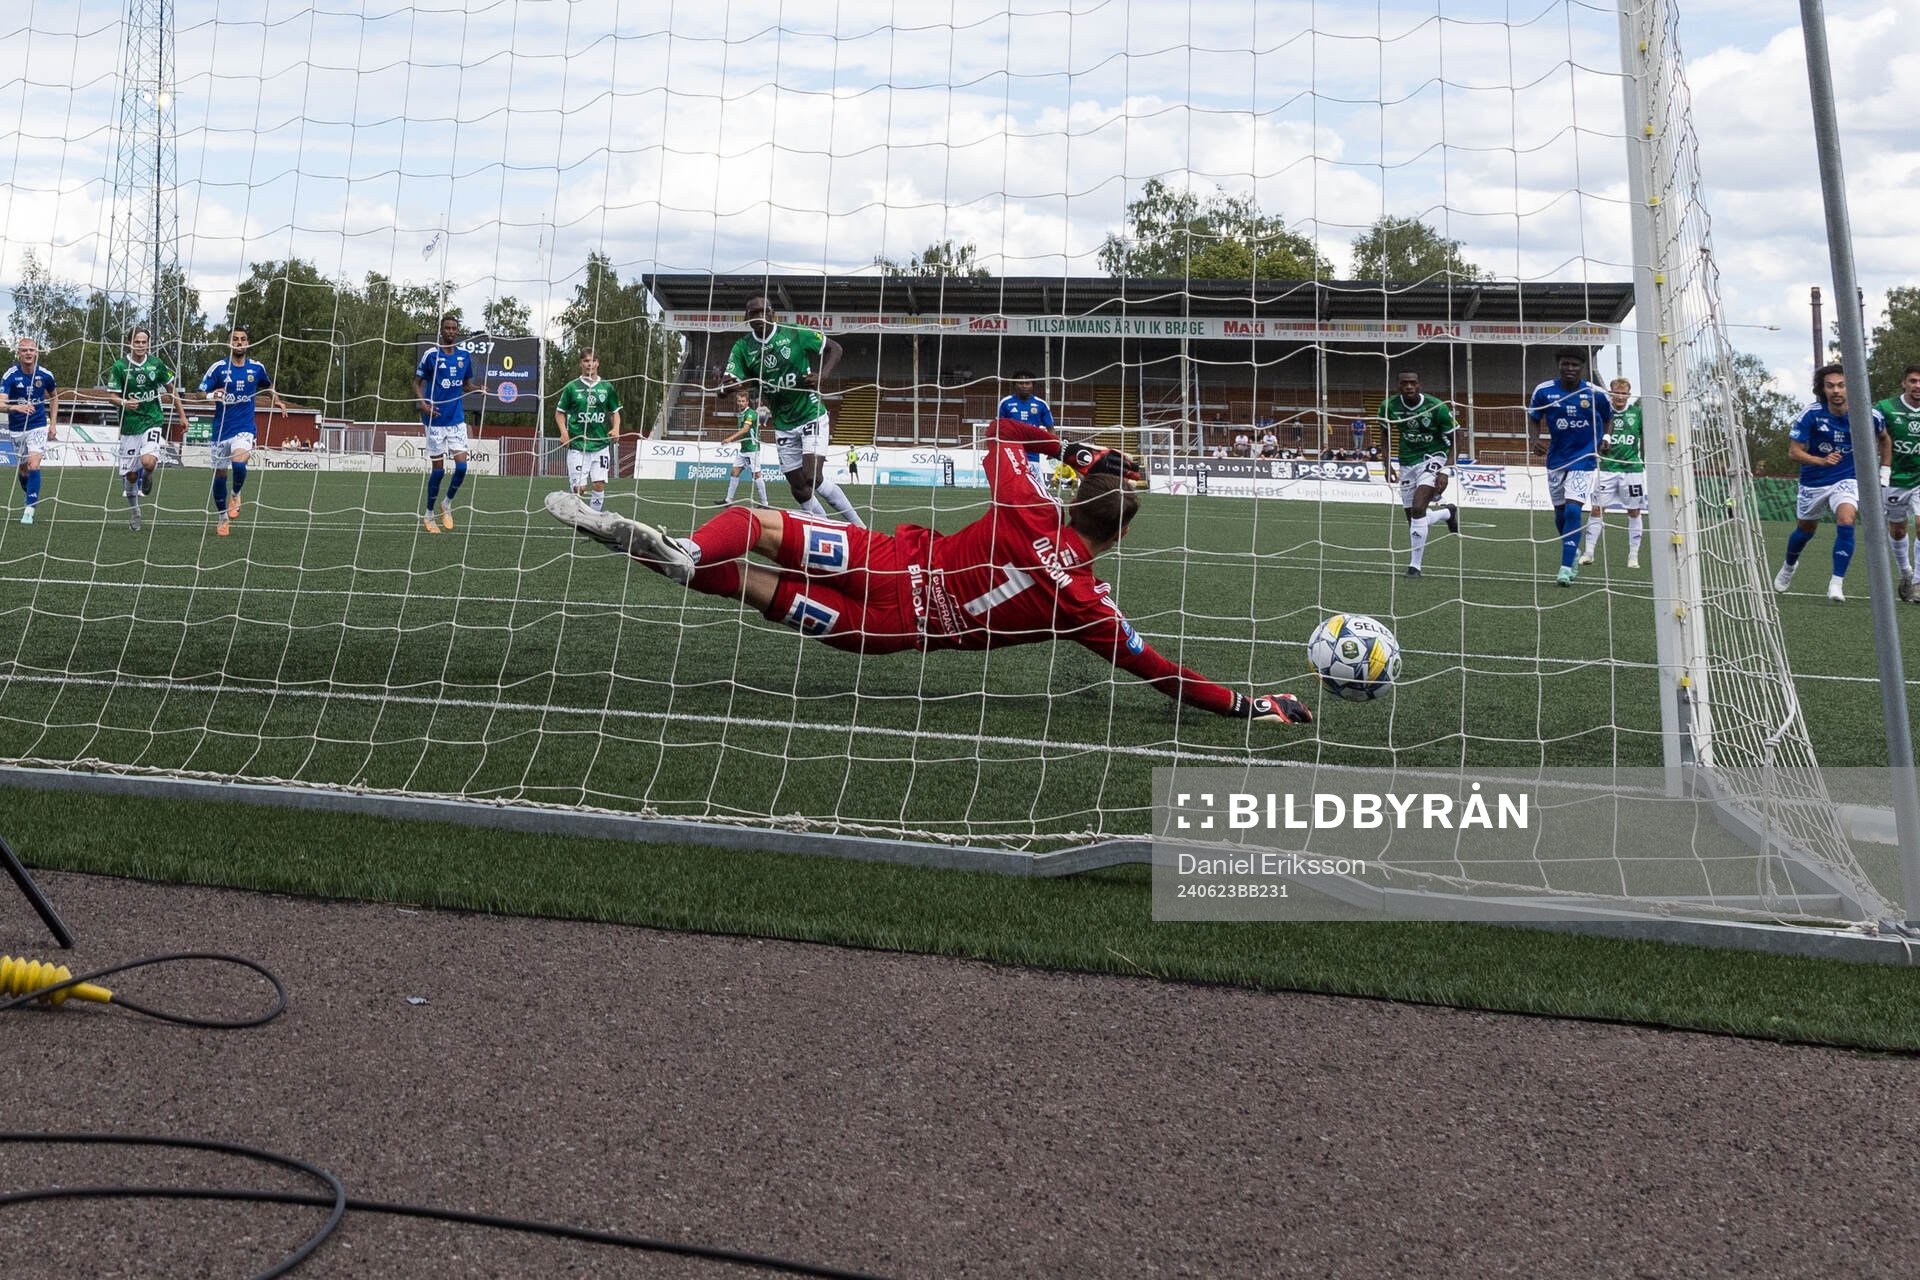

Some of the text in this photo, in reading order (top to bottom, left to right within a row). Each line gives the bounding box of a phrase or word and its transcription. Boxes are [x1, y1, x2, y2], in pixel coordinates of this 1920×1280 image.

[796, 314, 833, 327] MAXI
[969, 316, 1008, 329] MAXI
[1223, 320, 1265, 333] MAXI
[1026, 318, 1205, 336] TILLSAMMANS ÄR VI IK BRAGE
[1417, 323, 1461, 337] MAXI
[459, 341, 495, 354] 19:37
[503, 356, 513, 370] 0
[498, 370, 529, 378] Sundsvall
[577, 412, 605, 423] SSAB
[1569, 419, 1590, 428] SCA
[1609, 434, 1635, 445] SAB
[651, 445, 686, 457] SSAB
[714, 447, 741, 457] SSA
[1893, 440, 1920, 455] SSA
[911, 453, 946, 464] SSAB
[688, 464, 727, 474] factoring
[1218, 464, 1270, 473] DIGITAL
[1341, 465, 1367, 479] 99
[687, 471, 725, 480] gruppen
[1467, 470, 1497, 482] VAR
[1187, 485, 1284, 497] VSTANHEDE
[1032, 536, 1074, 589] OLSSON
[963, 561, 1036, 617] 1
